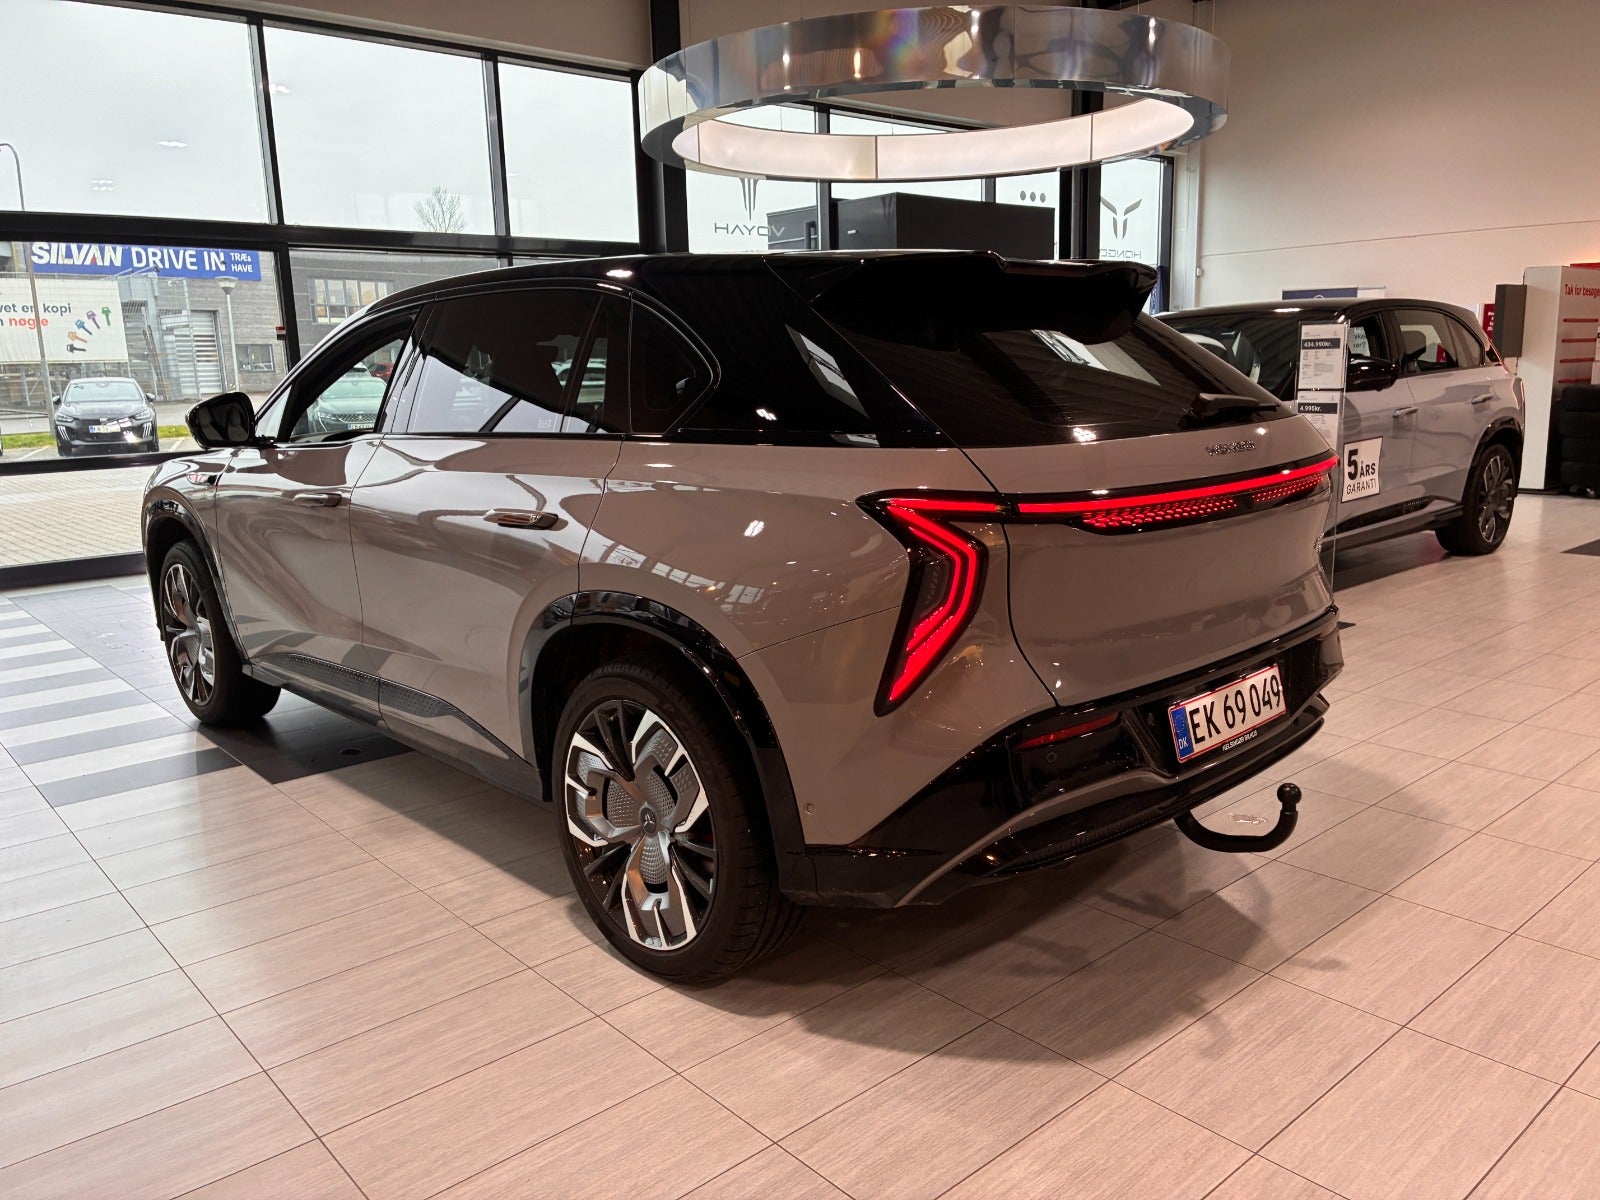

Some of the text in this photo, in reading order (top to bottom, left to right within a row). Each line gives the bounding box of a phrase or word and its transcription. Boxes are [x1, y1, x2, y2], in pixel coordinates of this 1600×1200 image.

[31, 241, 226, 272] SILVAN DRIVE IN
[231, 263, 253, 273] HAVE
[1565, 284, 1574, 296] Tak
[43, 303, 72, 316] kopi
[8, 318, 49, 330] nøge
[1347, 448, 1376, 480] 5 ÅRS
[1346, 478, 1377, 495] GARANTI
[1188, 674, 1281, 744] EK 69 049
[1178, 737, 1189, 750] DK
